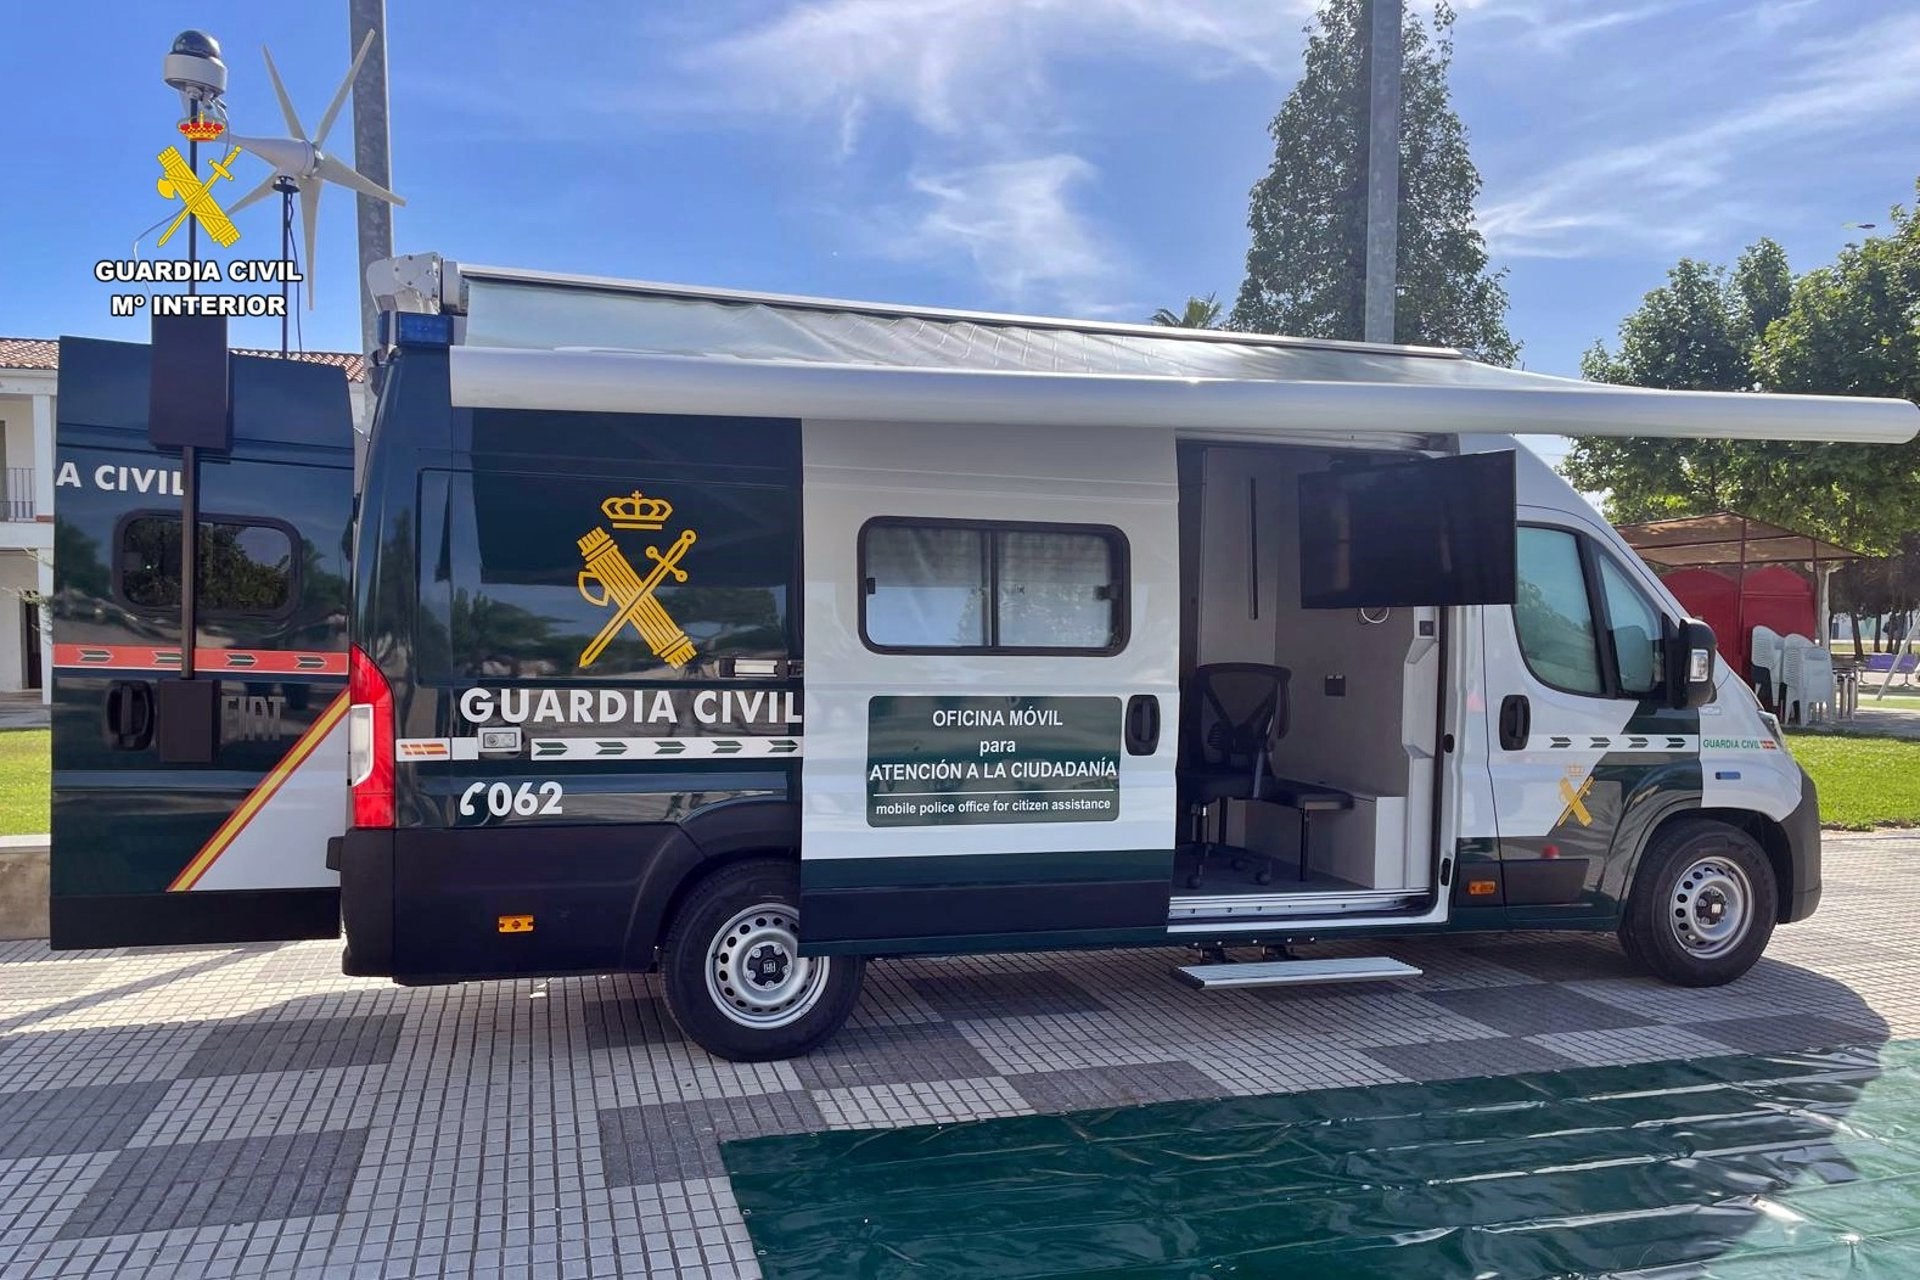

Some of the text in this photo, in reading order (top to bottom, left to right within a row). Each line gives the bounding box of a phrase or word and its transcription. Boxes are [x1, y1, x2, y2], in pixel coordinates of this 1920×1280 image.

[56, 461, 184, 496] A CIVIL
[459, 686, 803, 724] GUARDIA CIVIL
[932, 706, 1063, 727] OFICINA MÓVIL
[979, 740, 1016, 756] para
[1703, 739, 1760, 749] GUARDIA CIVIL
[869, 757, 1118, 781] ATENCIÓN A LA CIUDADANÍA
[488, 781, 564, 816] 062
[876, 798, 1111, 816] mobile police office for citizen assistance
